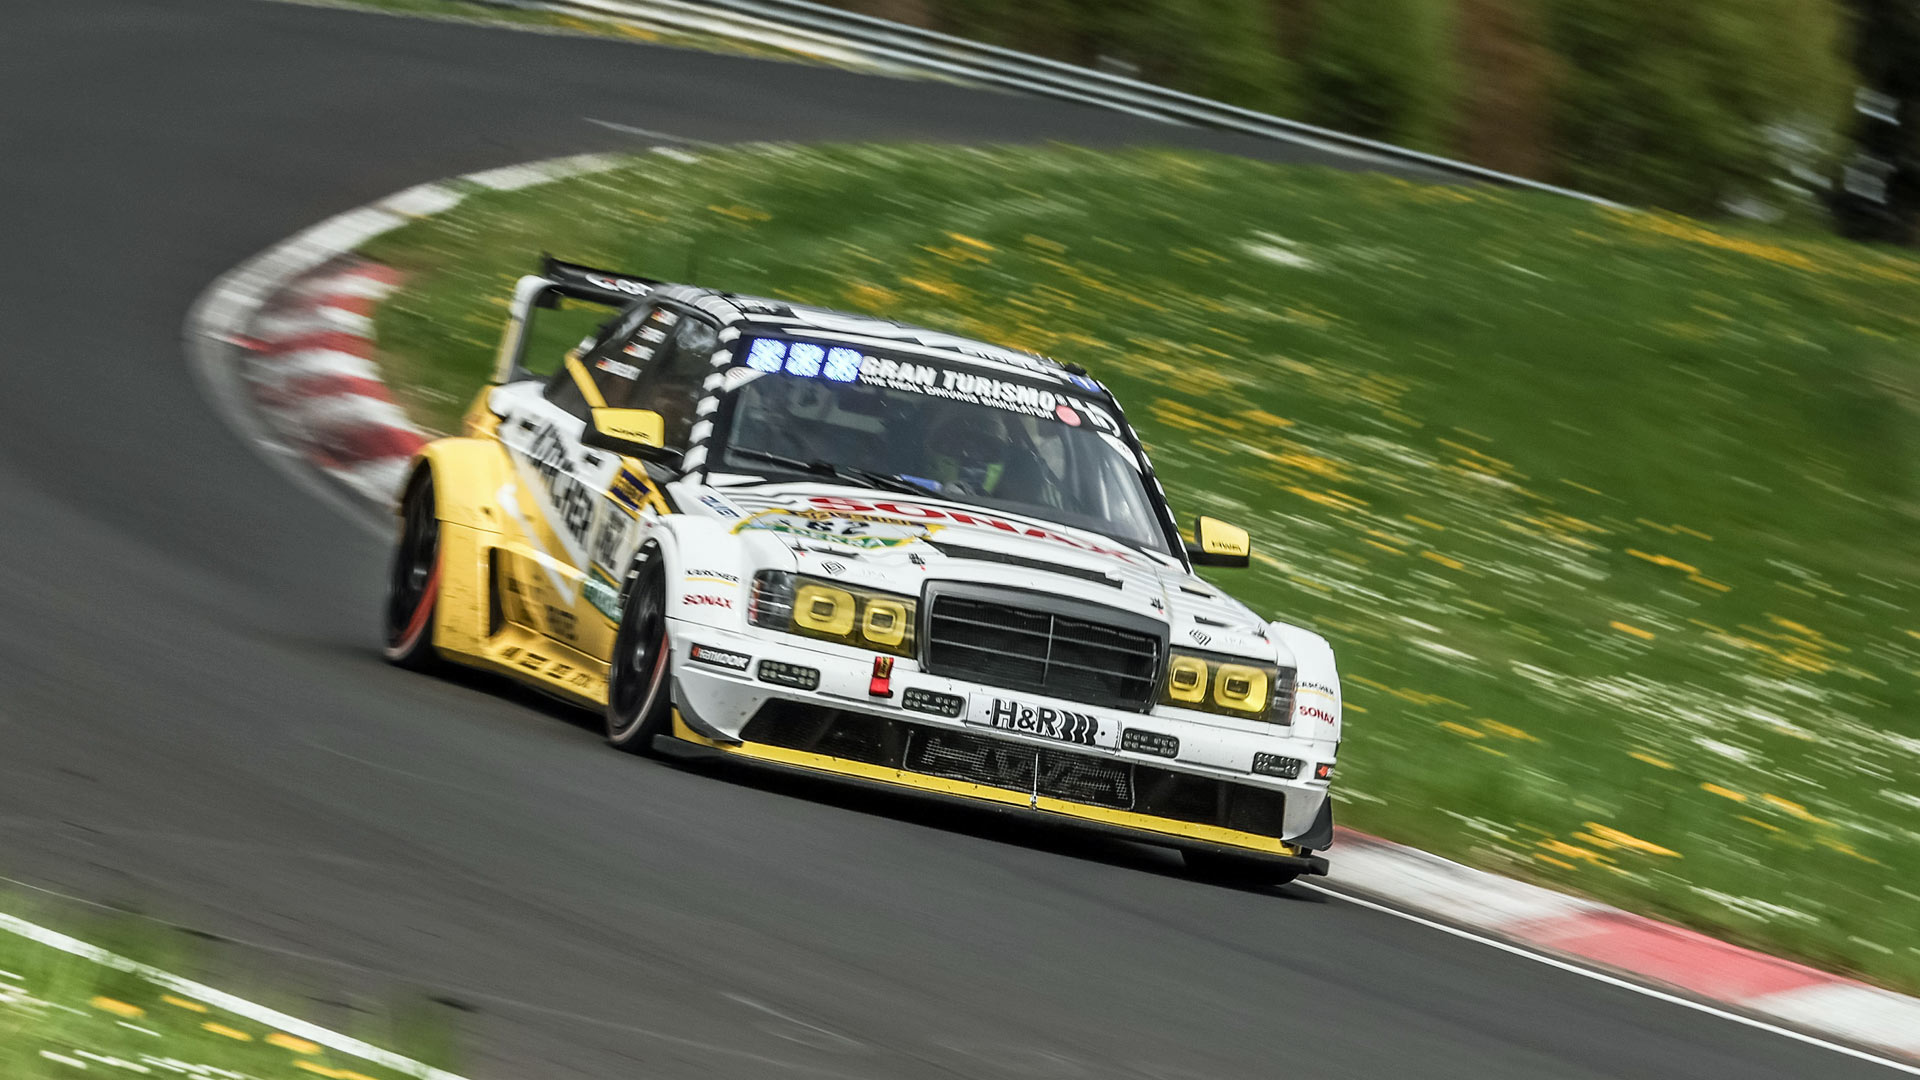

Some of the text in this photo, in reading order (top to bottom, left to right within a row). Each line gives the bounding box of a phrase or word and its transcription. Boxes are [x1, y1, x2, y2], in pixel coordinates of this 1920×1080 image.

[859, 355, 1056, 412] GRAN TURISMO
[923, 385, 980, 405] DRIVING
[983, 395, 1055, 421] SIMULATOR
[807, 496, 1136, 564] SONAX
[682, 593, 733, 610] SONAX
[990, 698, 1058, 737] H&R
[1299, 704, 1335, 727] SONAX
